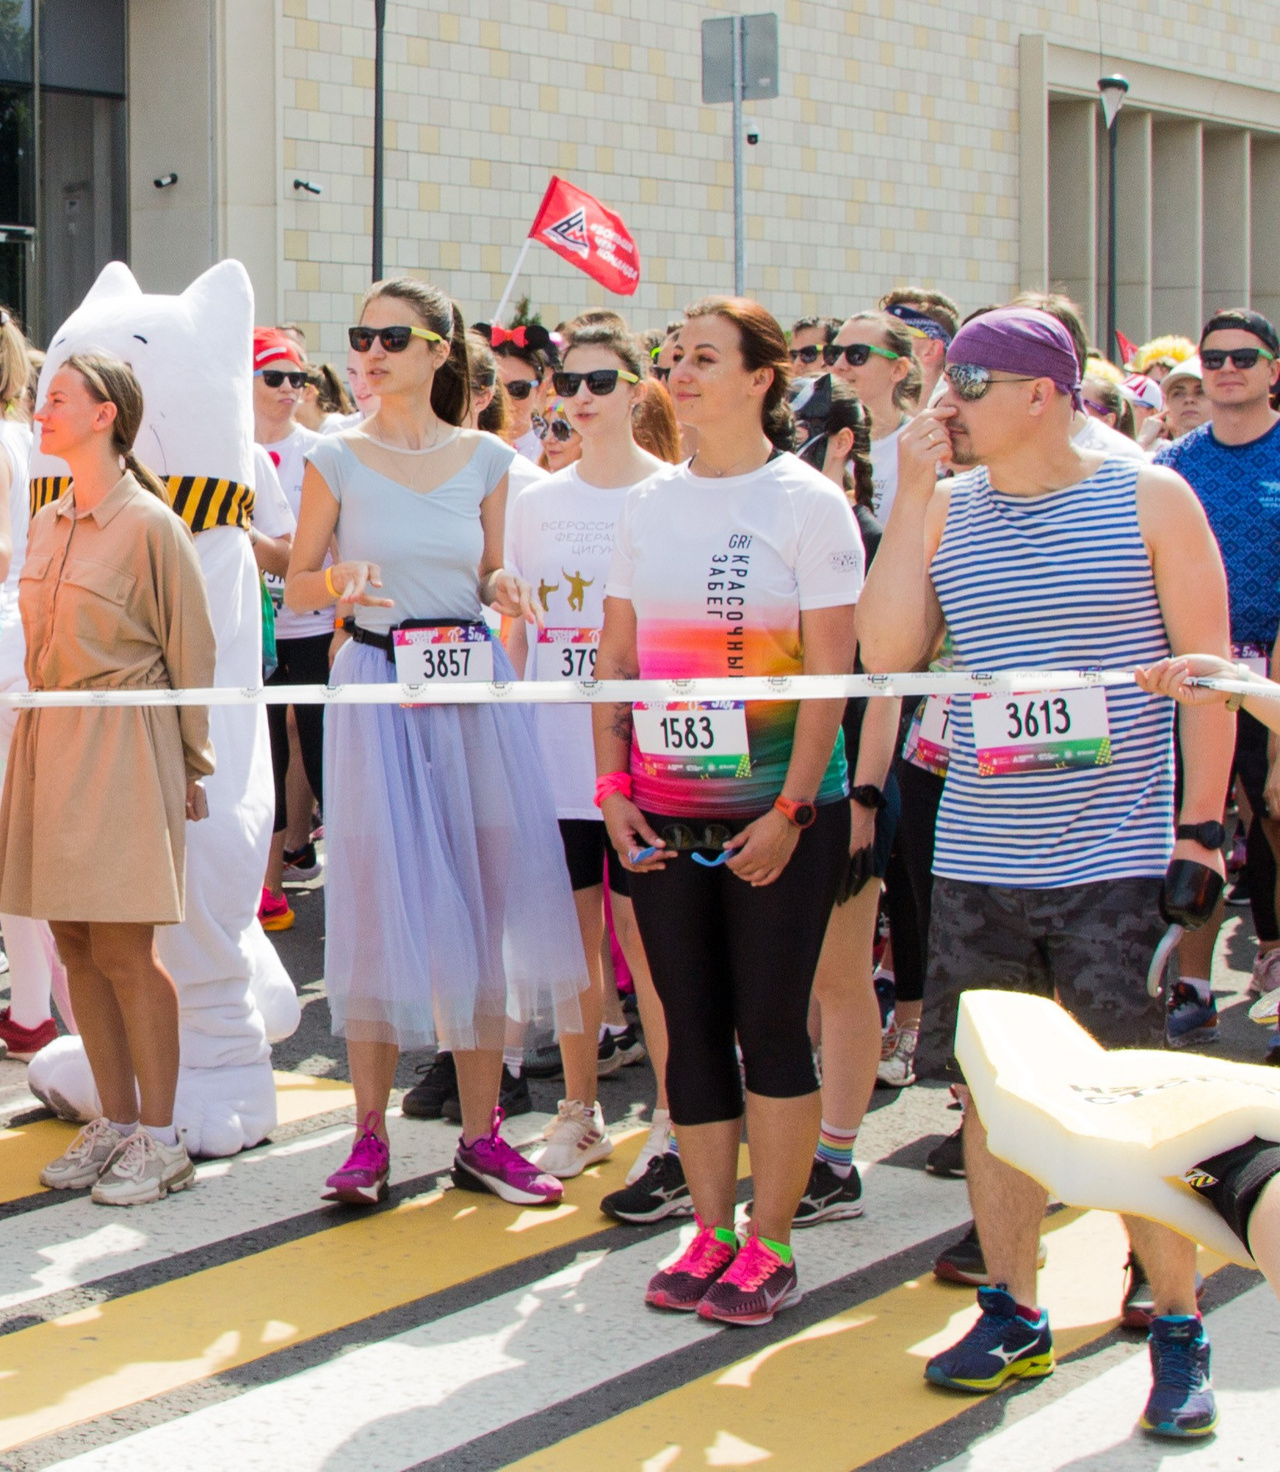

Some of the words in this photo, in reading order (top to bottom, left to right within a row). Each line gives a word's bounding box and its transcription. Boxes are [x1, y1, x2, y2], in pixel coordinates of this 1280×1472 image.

[541, 521, 615, 531] ВСЕРОССИ
[554, 532, 615, 544] ФЕДЕРА
[707, 554, 728, 619] ЗАБЕГ
[726, 554, 750, 678] КРАСОЧНЫ
[423, 648, 471, 679] 3857
[561, 648, 598, 677] 379
[660, 716, 714, 749] 1583
[1006, 697, 1071, 739] 3613
